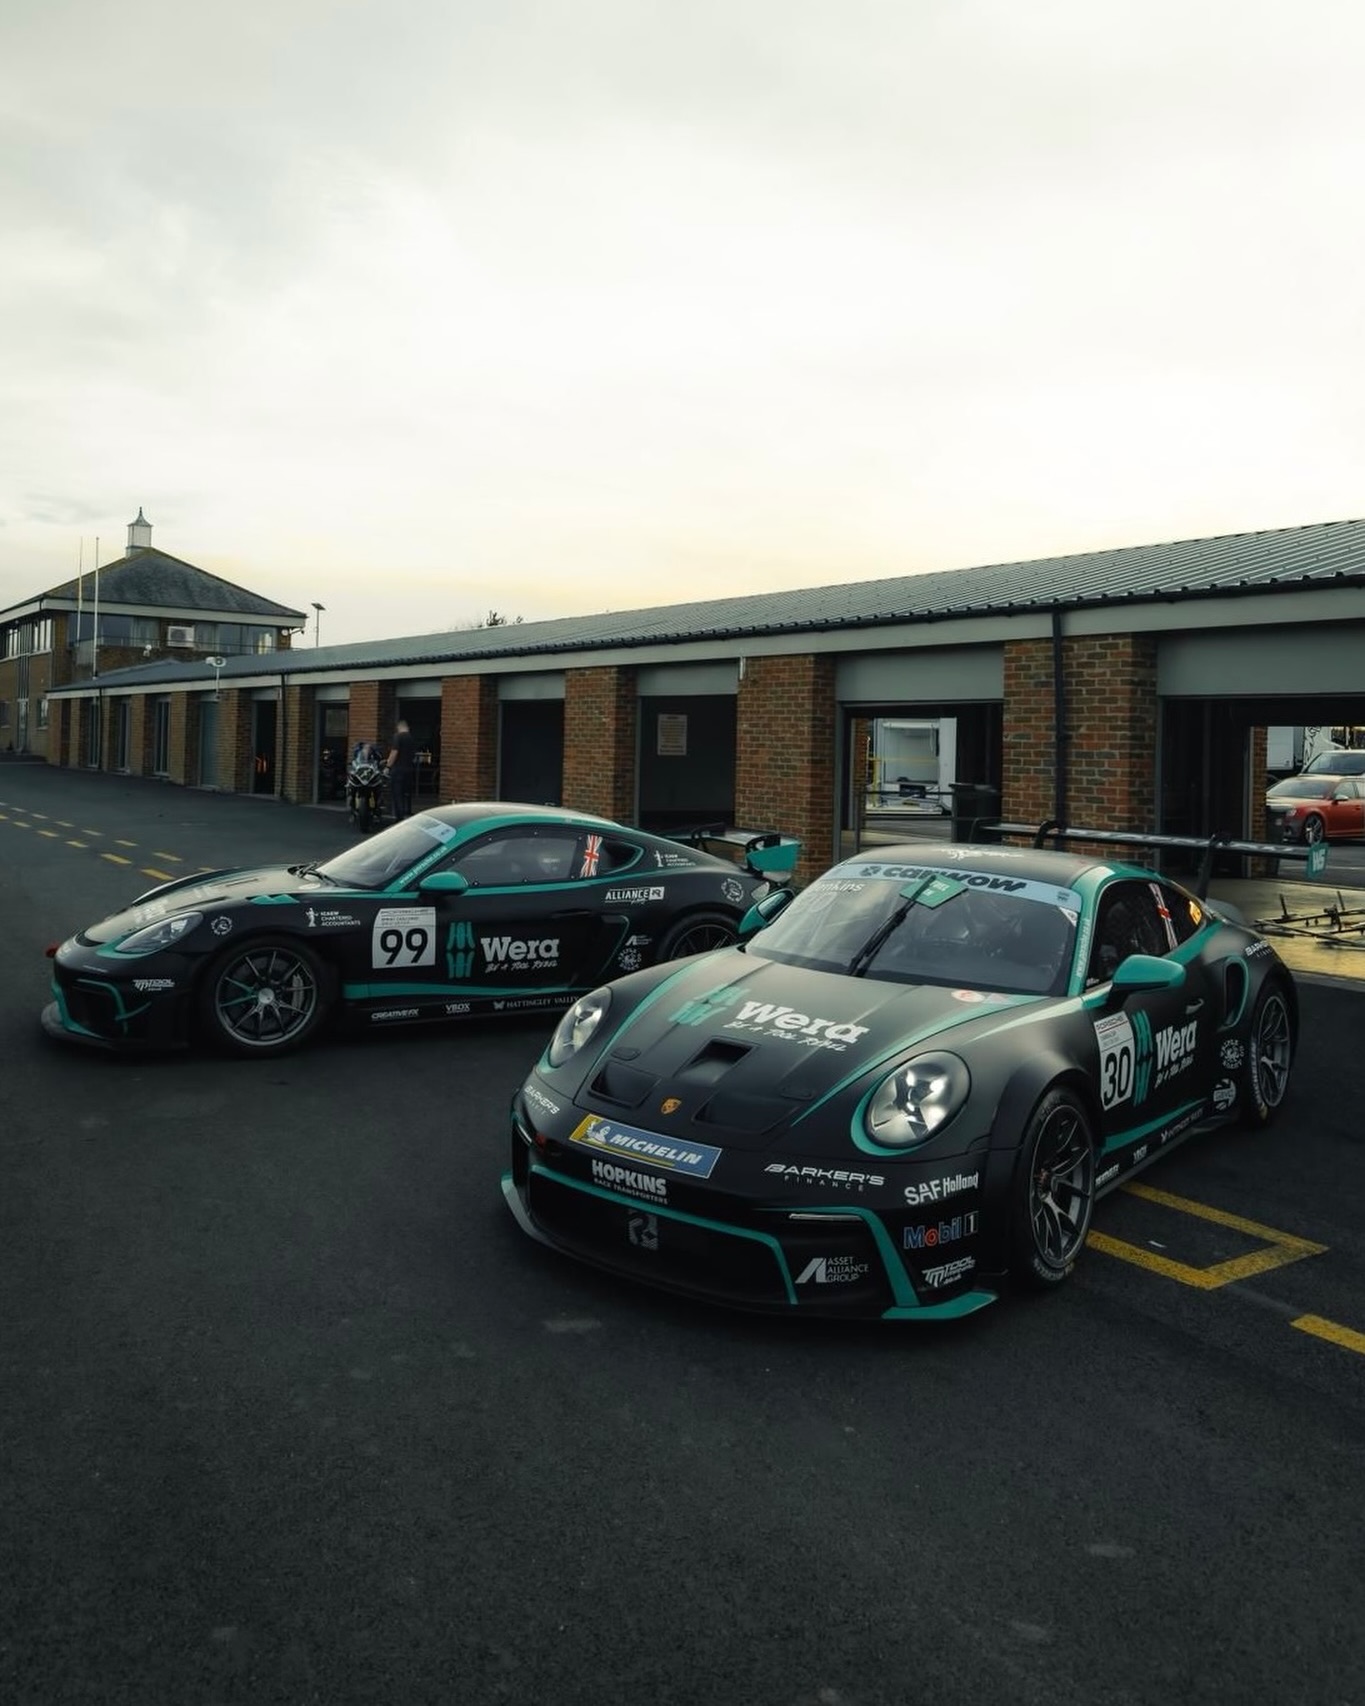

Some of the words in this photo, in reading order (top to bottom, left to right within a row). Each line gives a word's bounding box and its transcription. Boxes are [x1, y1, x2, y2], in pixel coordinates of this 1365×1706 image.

[605, 889, 649, 900] ALLIANCE
[380, 928, 428, 965] 99
[480, 936, 560, 962] Wera
[506, 997, 551, 1008] HATTINGLEY
[736, 1001, 870, 1044] Wera
[1155, 1020, 1198, 1072] Wera
[1104, 1046, 1131, 1106] 30
[609, 1133, 702, 1165] MICHELIN
[592, 1158, 668, 1197] HOPKINS
[763, 1163, 885, 1186] BARKER'S
[784, 1175, 864, 1192] FINANCE
[904, 1179, 941, 1205] SAF
[942, 1170, 979, 1197] Holland
[903, 1216, 962, 1250] Mobil
[827, 1264, 870, 1275] ALLIANCE
[828, 1256, 854, 1265] ASSET
[827, 1273, 860, 1282] GROUP
